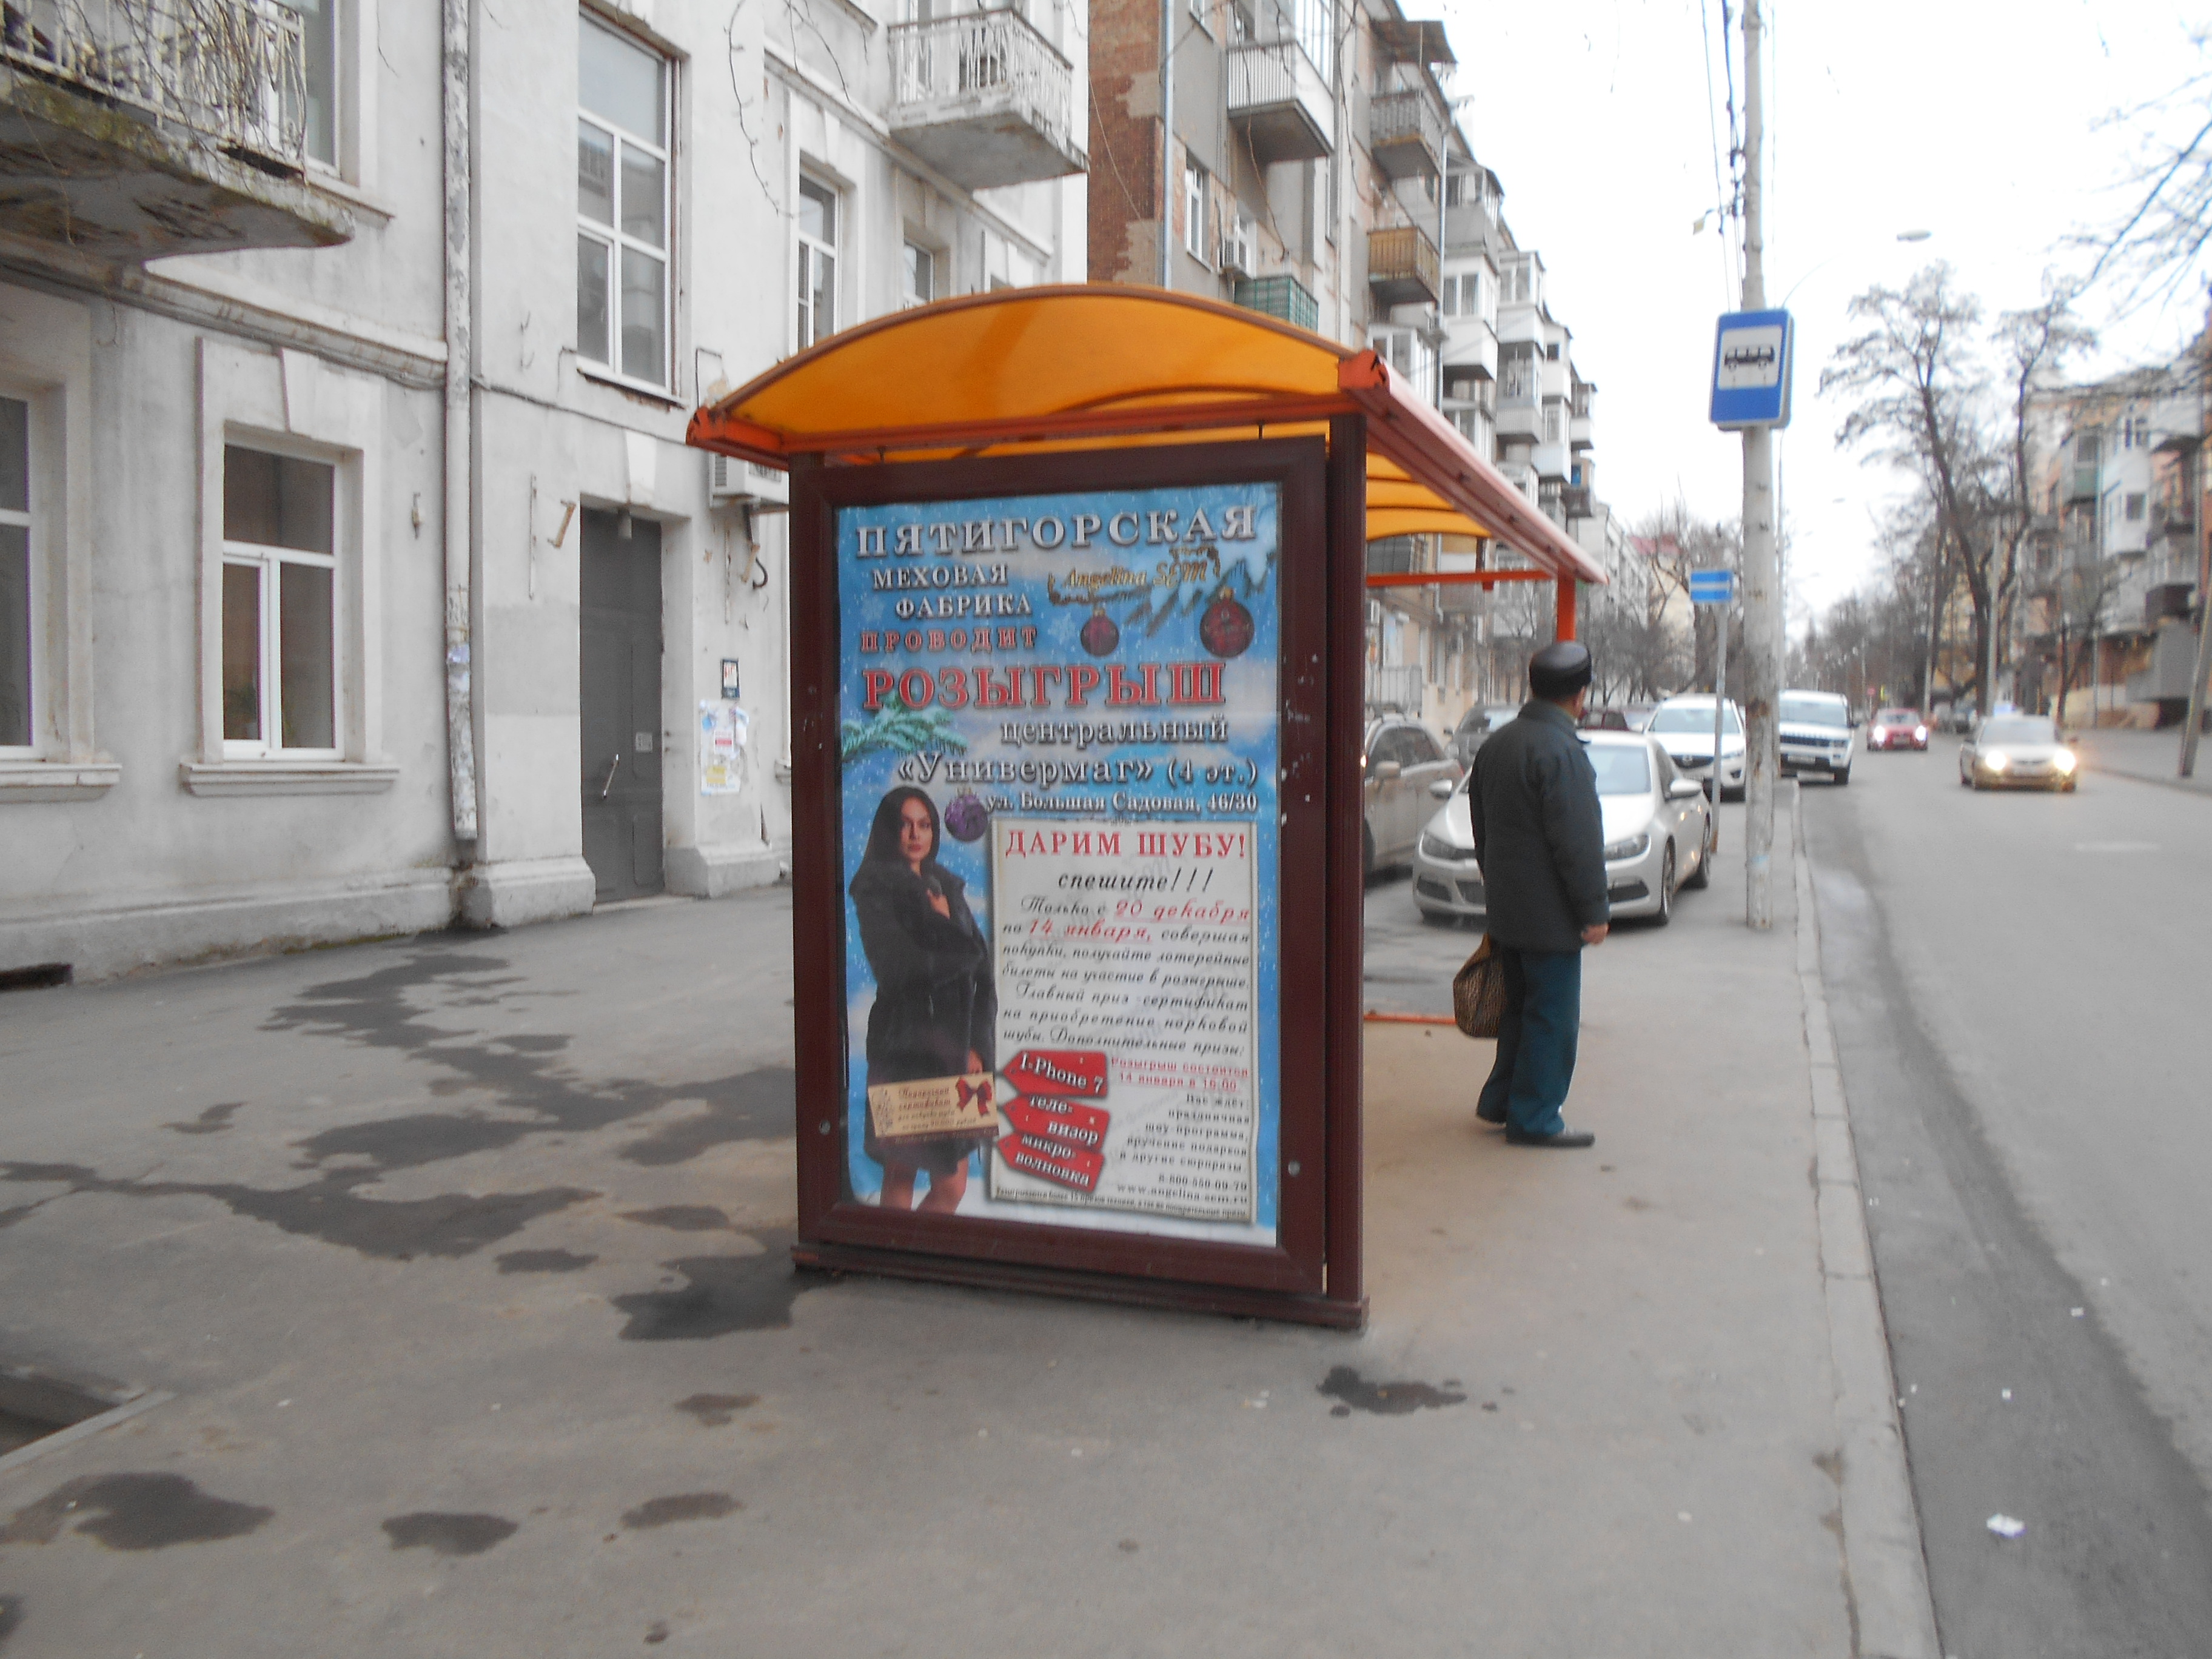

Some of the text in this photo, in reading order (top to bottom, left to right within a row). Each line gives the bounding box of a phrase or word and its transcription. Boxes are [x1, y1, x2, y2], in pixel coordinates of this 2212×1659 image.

[856, 506, 1256, 558] ПЯТИГОРСКАЯ
[873, 563, 1008, 591] МЕХОВАЯ
[1062, 565, 1148, 591] Angelina
[896, 592, 1032, 620] ФАБРИКА
[860, 625, 1037, 653] ПРОВОДИТ
[862, 662, 1226, 711] РОЗЫГРЫШ
[1001, 713, 1228, 749] центральный
[898, 749, 1258, 789] «Универмаг» (4 эт.)
[985, 791, 1259, 814] ул. Большая Садовая, 46/30
[1005, 829, 1246, 859] ДАРИМ ШУБУ!
[1021, 894, 1090, 915] Только
[1116, 899, 1142, 917] 20
[1154, 897, 1251, 924] декабря
[1003, 917, 1250, 947] по 14 января, совершая
[1003, 941, 1250, 968] покупки, получайте лотерейные
[1002, 960, 1055, 979] билеты
[1061, 970, 1078, 980] на
[1082, 971, 1144, 985] участие
[1016, 979, 1085, 1001] Главный
[1091, 991, 1130, 1007] приз
[1004, 1007, 1248, 1034] на приобретение норковой
[1050, 1025, 1187, 1053] Дополнительные
[1020, 1053, 1104, 1094] I-Phone 7
[1111, 1057, 1248, 1078] Розыгрыш состоится
[1030, 1095, 1073, 1114] теле-
[1168, 1110, 1249, 1124] праздничная
[1022, 1134, 1076, 1159] микро-
[1047, 1121, 1098, 1146] визор
[1191, 1142, 1247, 1157] подарков
[1015, 1151, 1090, 1187] волновка
